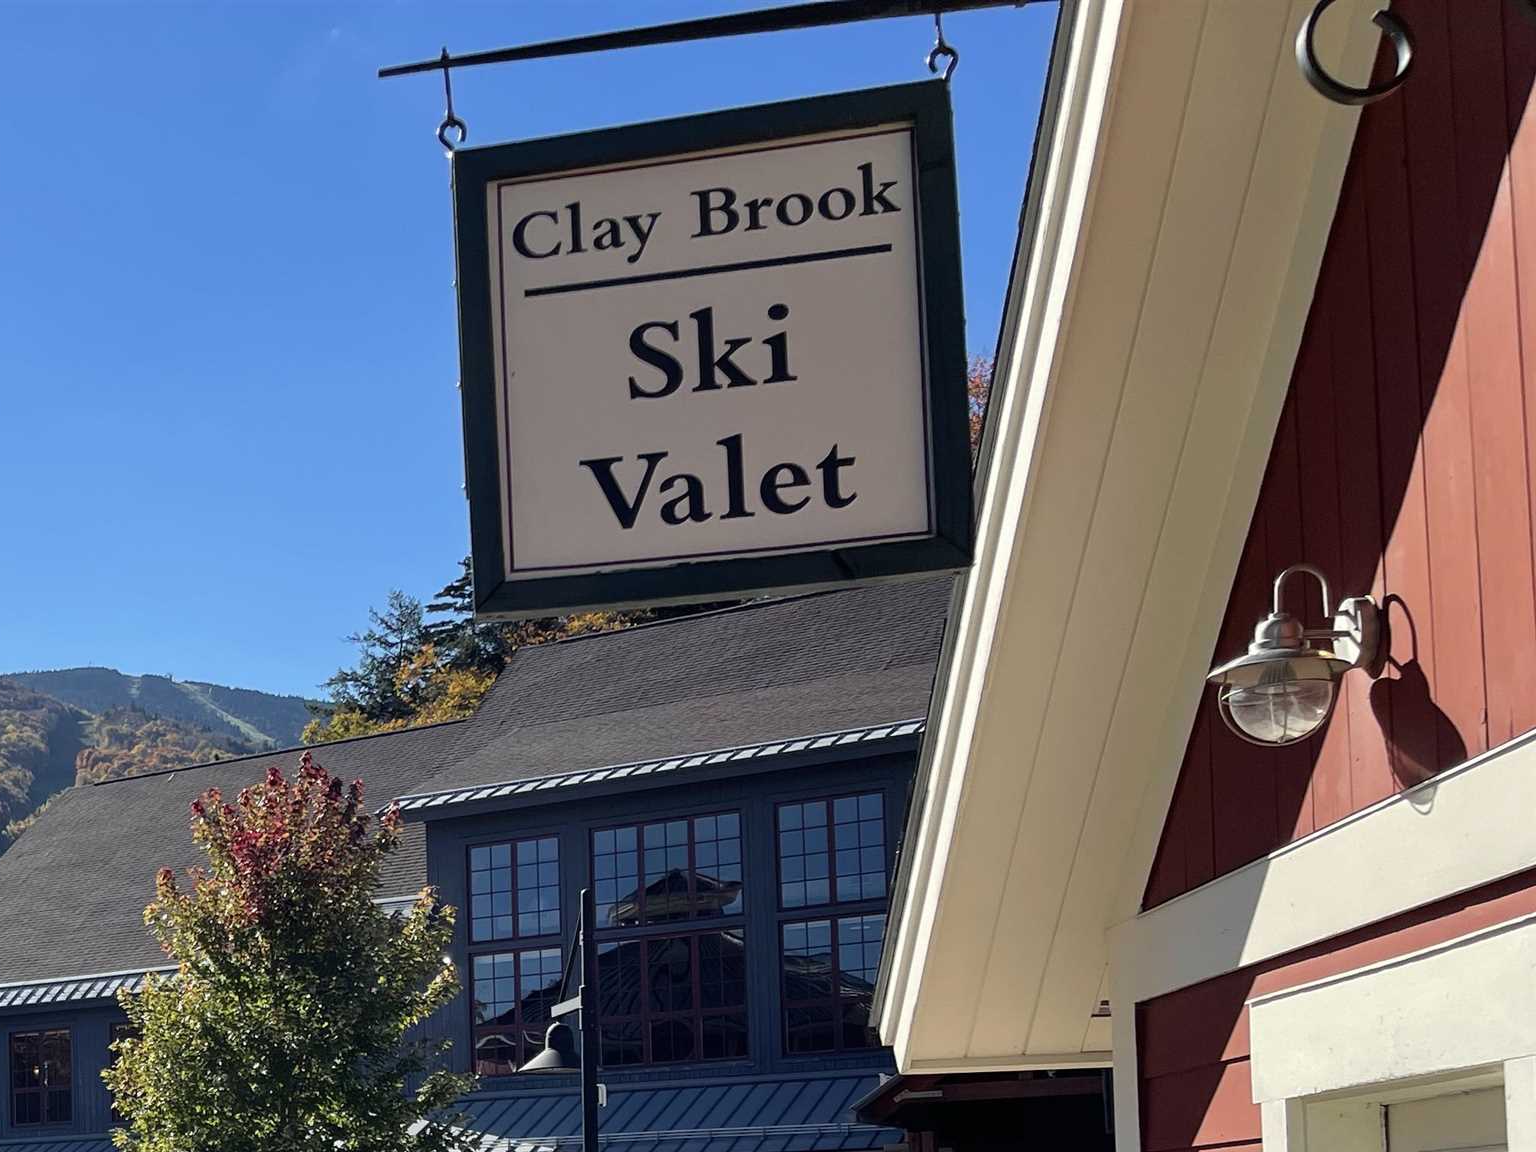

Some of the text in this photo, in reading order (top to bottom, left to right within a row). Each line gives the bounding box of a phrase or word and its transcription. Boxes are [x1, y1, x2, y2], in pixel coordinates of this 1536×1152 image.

[513, 163, 901, 264] Clay Brook
[628, 304, 797, 400] Ski
[580, 434, 857, 529] Valet
